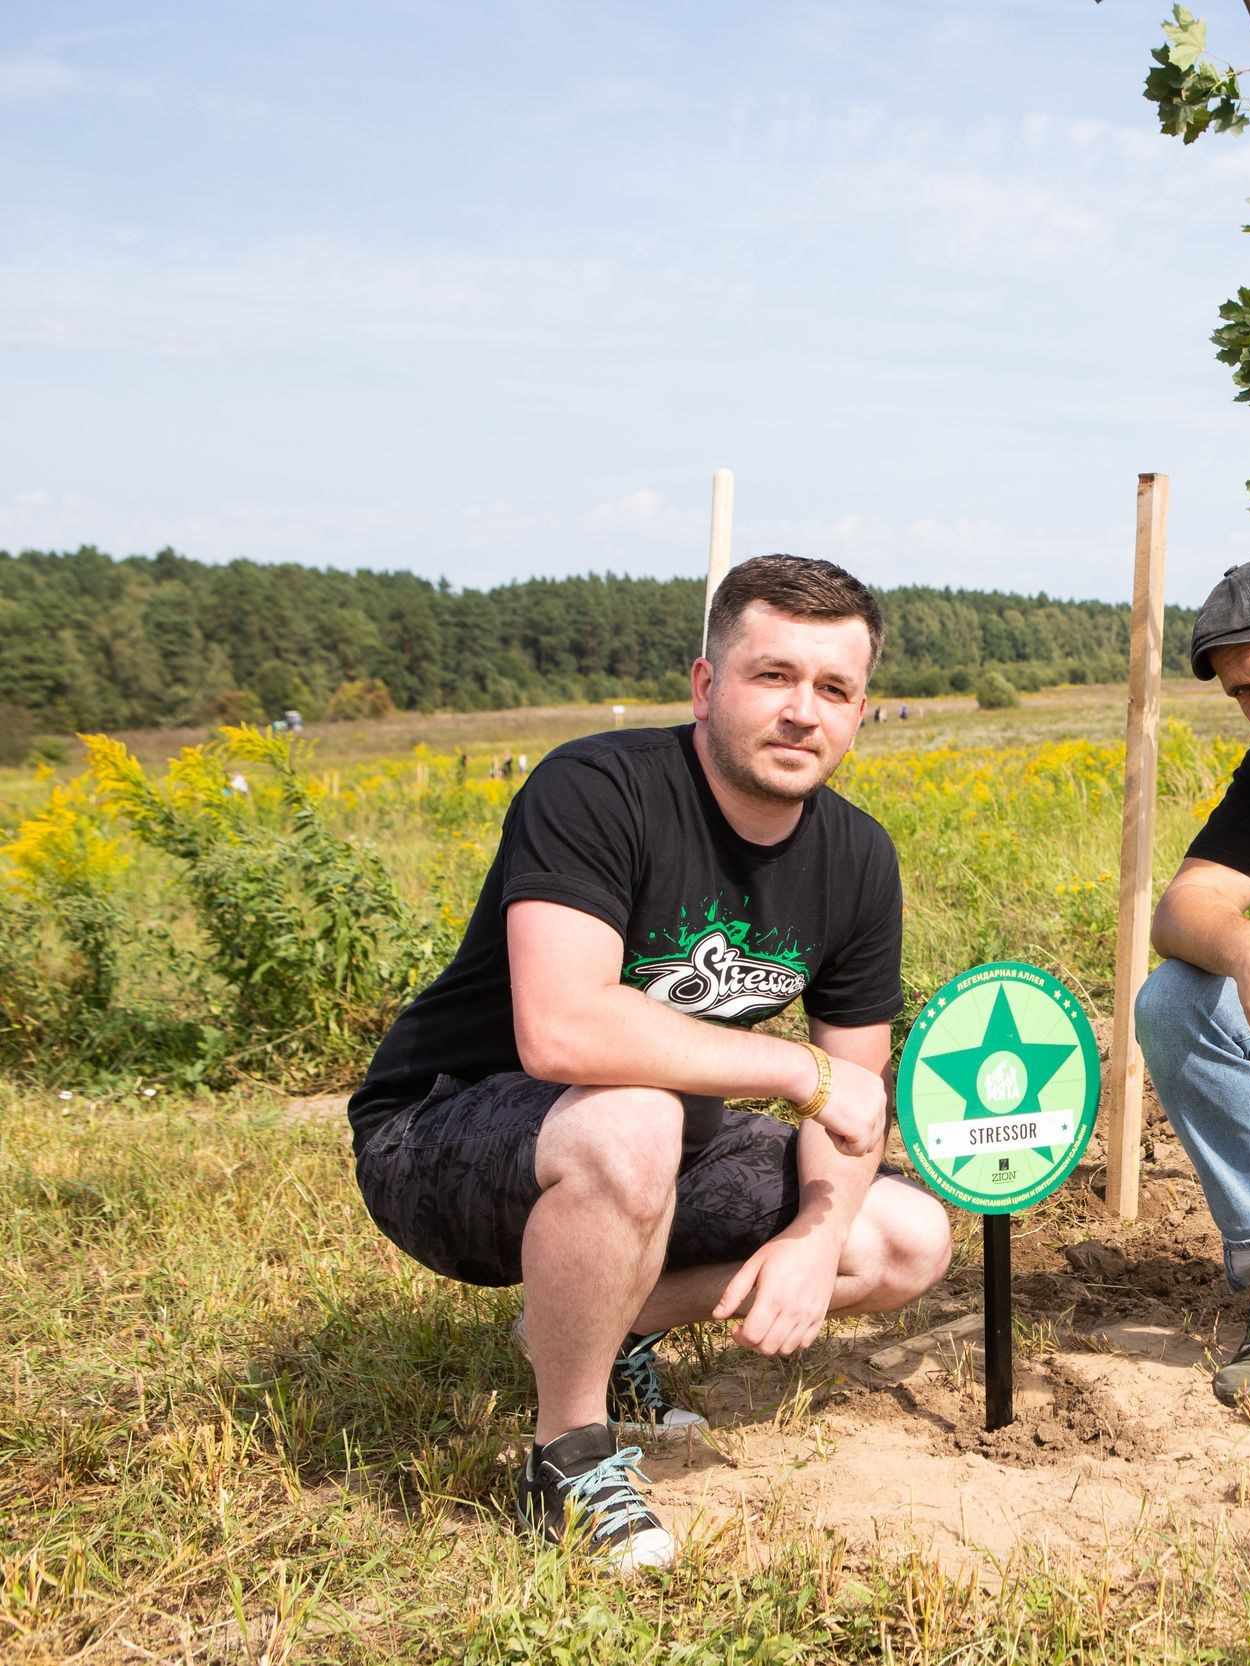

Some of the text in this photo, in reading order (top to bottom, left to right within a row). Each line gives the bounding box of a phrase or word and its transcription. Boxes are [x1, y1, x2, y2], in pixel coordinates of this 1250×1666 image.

[956, 969, 1045, 992] ЛЕГЕНДАРНАЯ АЛЛЕЯ
[969, 1122, 1037, 1146] STRESSOR
[912, 1142, 938, 1180] ЗАЛОЖЕНА
[941, 1181, 957, 1195] 2021
[954, 1190, 973, 1203] ГОДУ
[992, 1171, 1016, 1182] ZION
